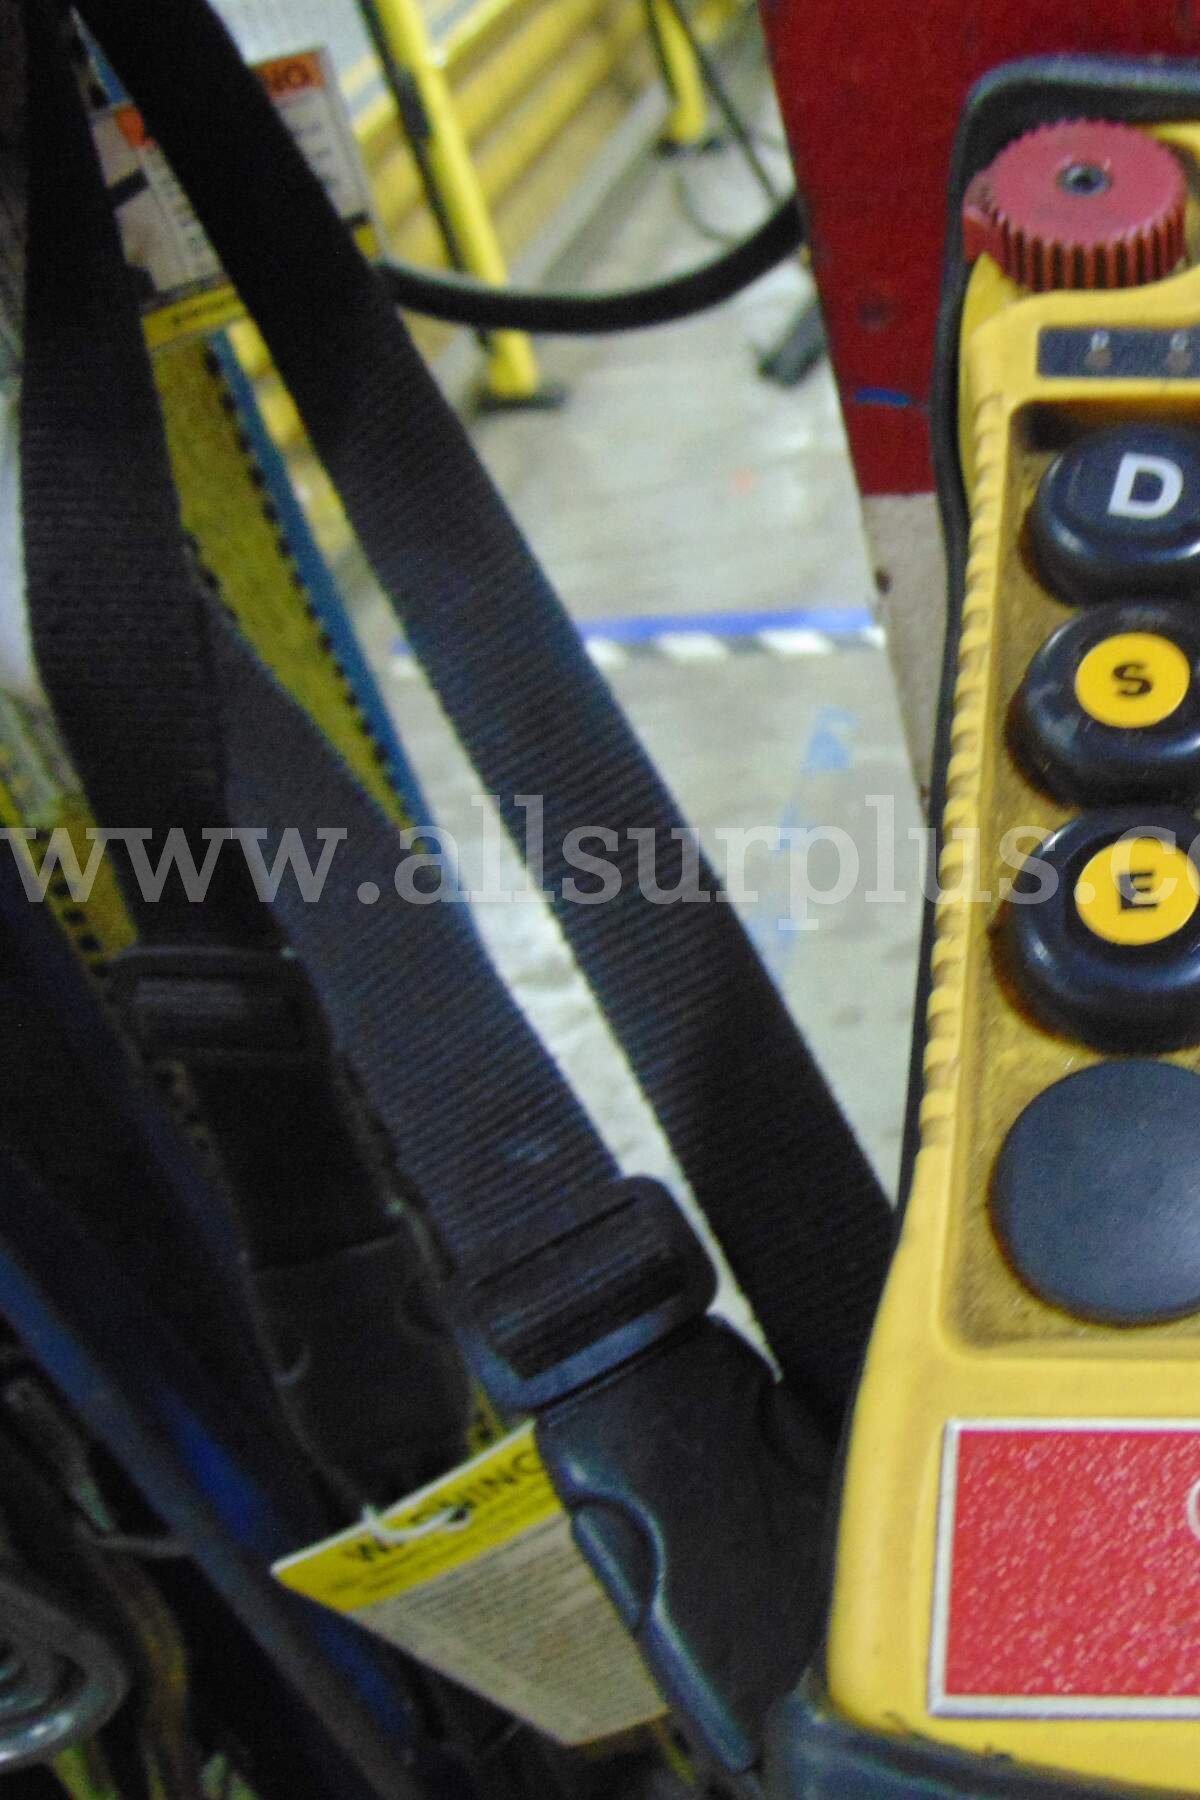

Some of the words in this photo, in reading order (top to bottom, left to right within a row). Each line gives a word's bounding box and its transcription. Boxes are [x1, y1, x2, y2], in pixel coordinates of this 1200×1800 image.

[1107, 453, 1184, 520] D
[1112, 662, 1153, 698] S
[1117, 868, 1157, 914] E
